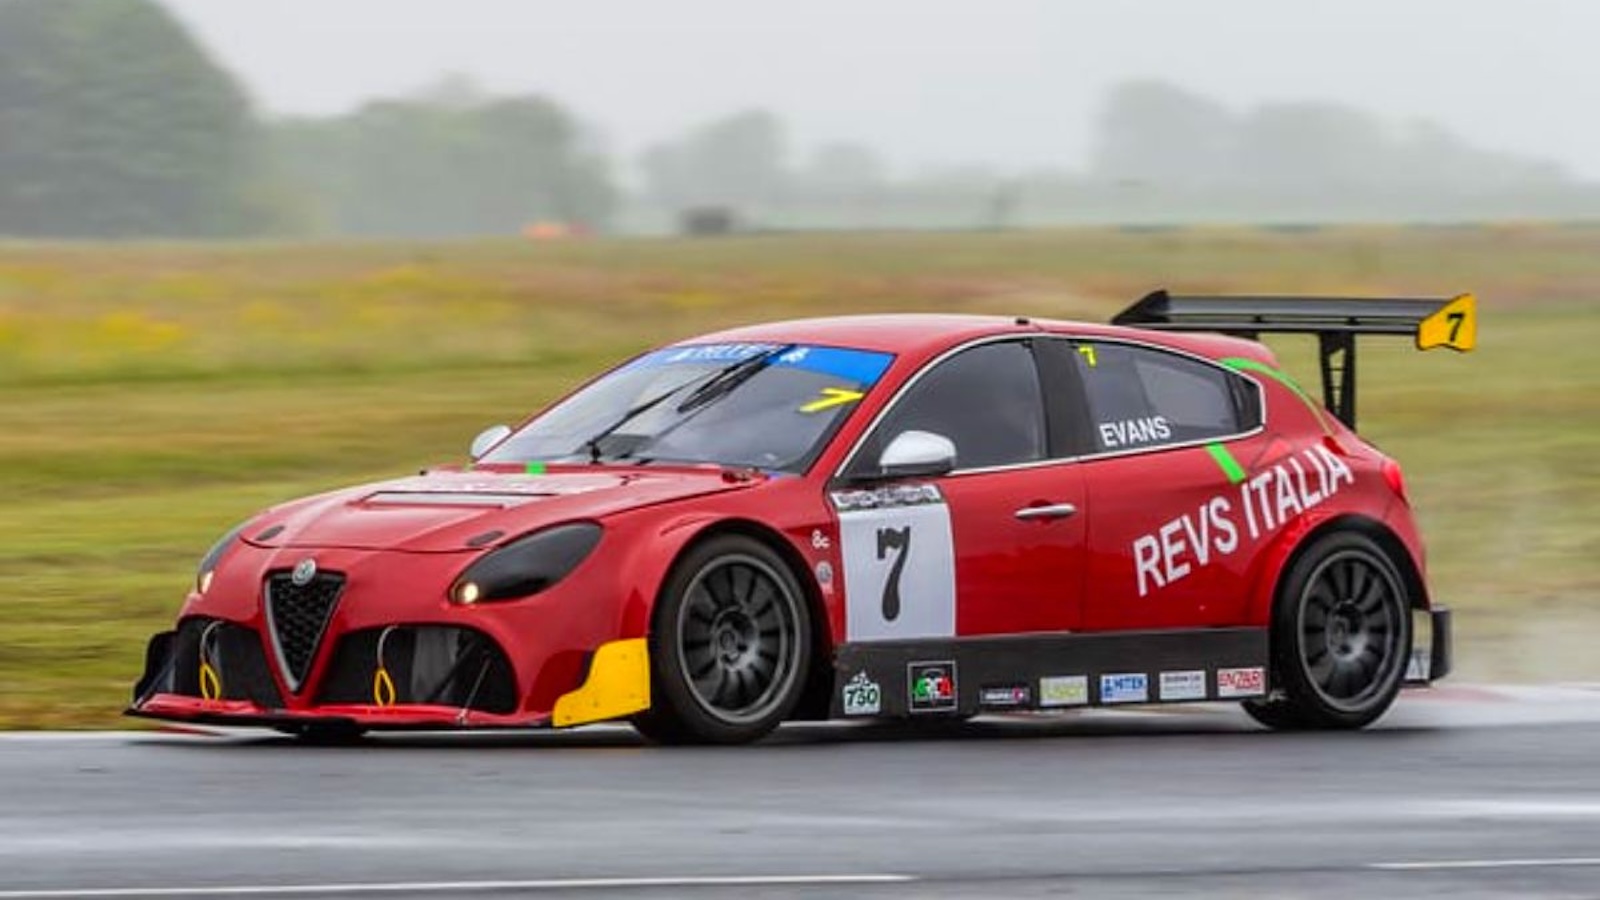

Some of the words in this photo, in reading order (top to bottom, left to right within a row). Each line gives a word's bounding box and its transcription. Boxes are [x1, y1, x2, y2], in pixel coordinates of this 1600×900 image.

[1447, 313, 1464, 342] 7
[1079, 345, 1096, 367] 7
[798, 387, 864, 413] 7
[1099, 416, 1171, 447] EVANS
[1133, 496, 1238, 597] REVS
[1241, 443, 1354, 539] ITALIA
[877, 526, 910, 621] 7
[846, 689, 877, 706] 730
